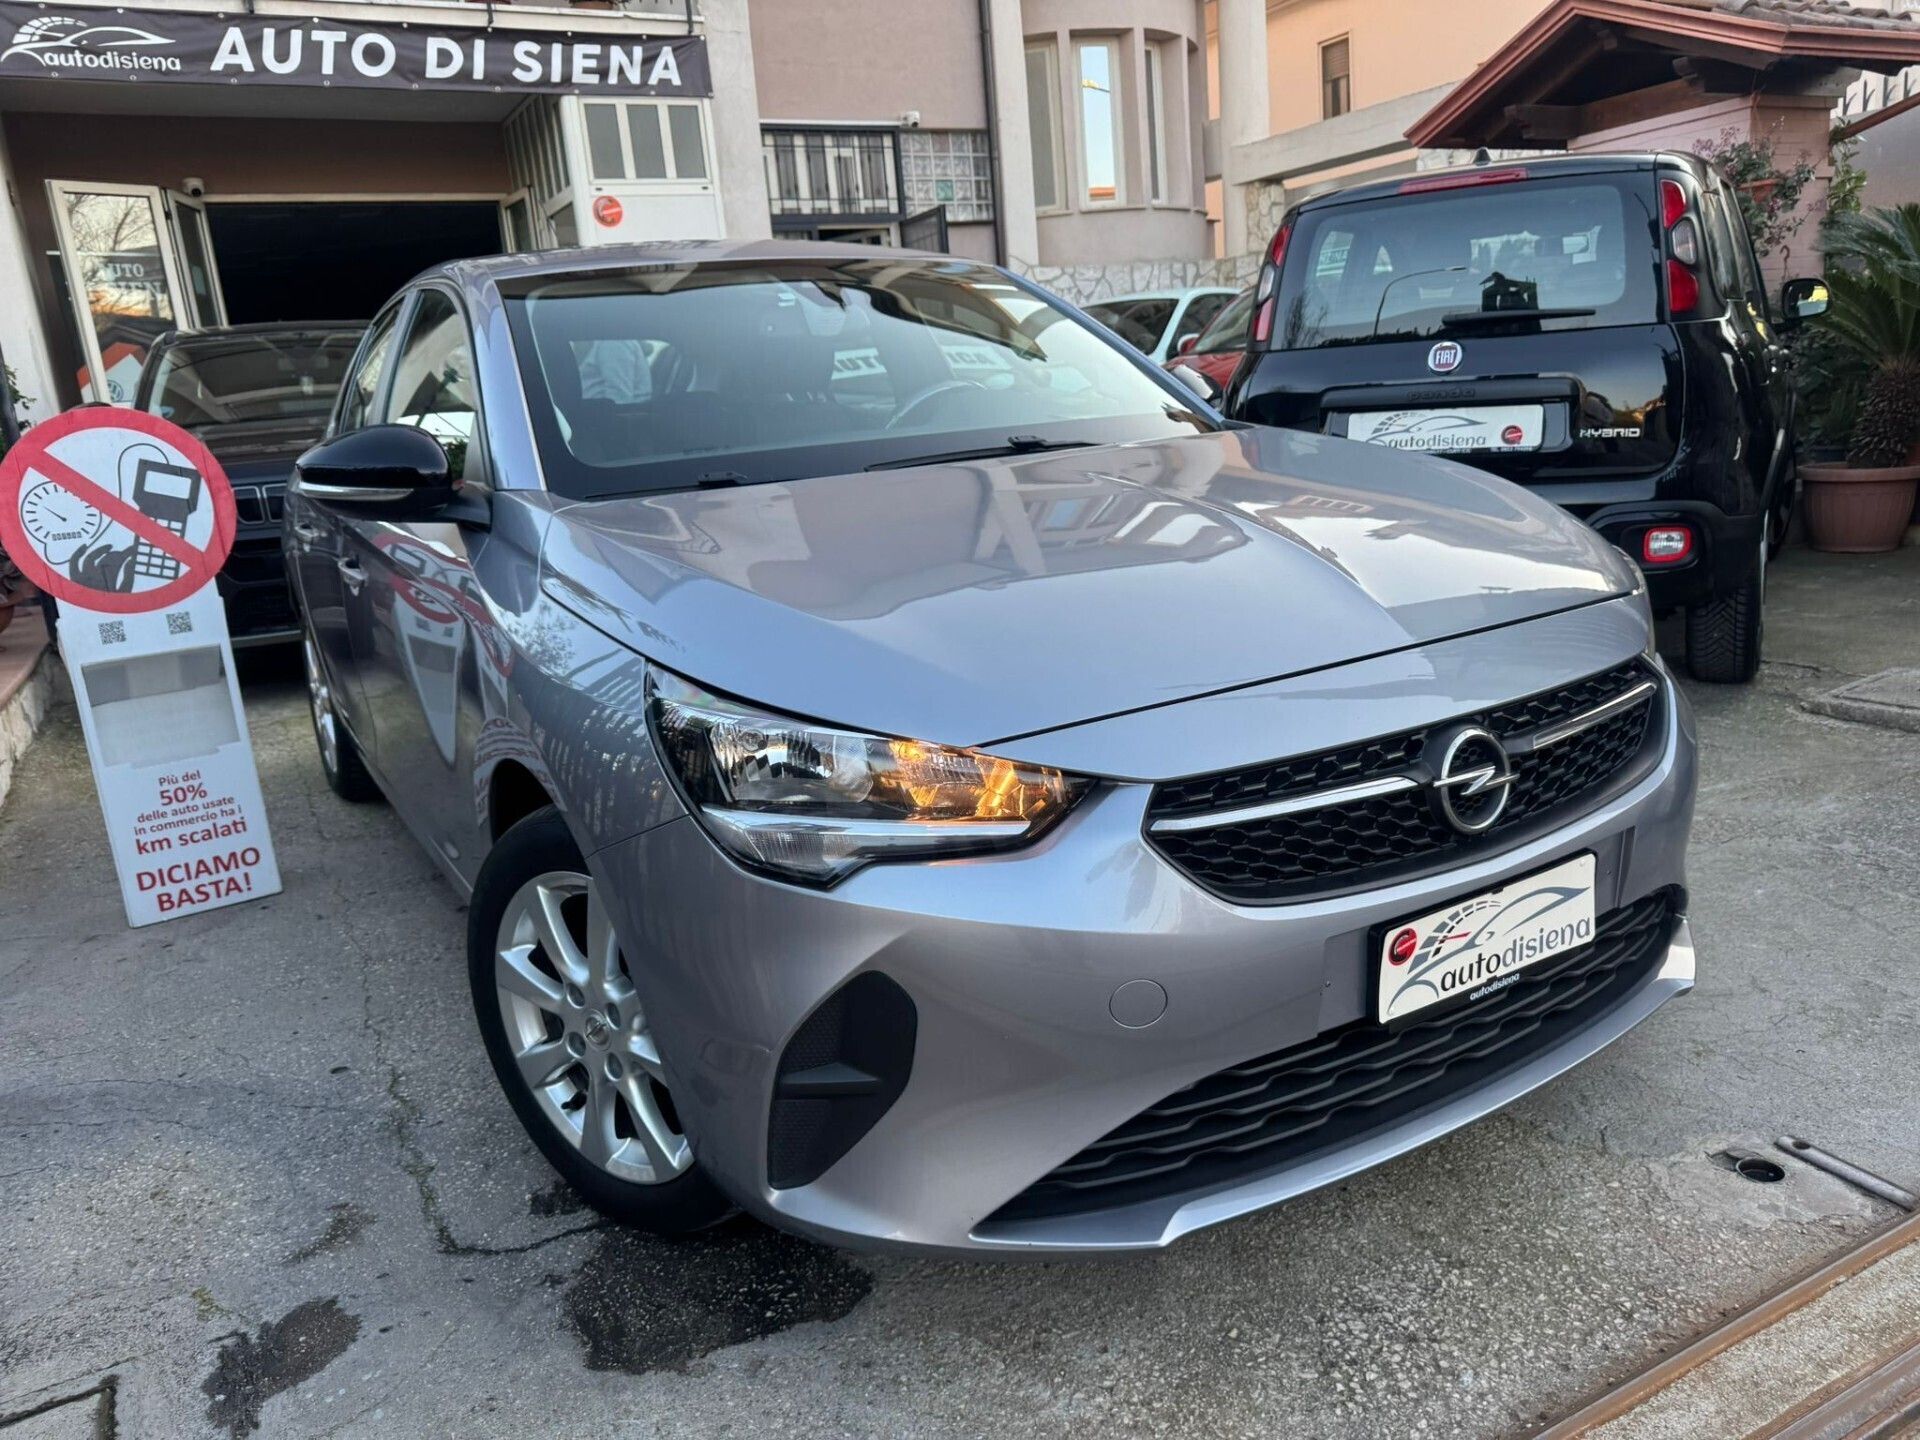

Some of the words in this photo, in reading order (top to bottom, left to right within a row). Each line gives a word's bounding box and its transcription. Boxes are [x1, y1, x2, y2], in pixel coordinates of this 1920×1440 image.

[44, 50, 181, 72] autodisiena
[209, 27, 396, 77] AUTO
[425, 37, 485, 80] DI
[512, 41, 682, 86] SIENA
[1435, 349, 1456, 364] FIAT
[1388, 434, 1487, 449] autodisiena
[1579, 427, 1640, 438] HYBRID
[158, 774, 179, 787] Più
[182, 770, 202, 782] del
[159, 782, 208, 806] 50%
[134, 826, 146, 836] in
[150, 812, 218, 833] commercio
[220, 808, 236, 818] ha
[137, 808, 168, 824] delle
[171, 804, 200, 817] auto
[202, 796, 235, 810] usate
[135, 837, 172, 855] km
[178, 816, 248, 846] scalati
[136, 847, 261, 892] DICIAMO
[156, 872, 252, 912] BASTA!
[1440, 916, 1591, 992] autodisiena
[1469, 972, 1521, 1001] autodisiena
